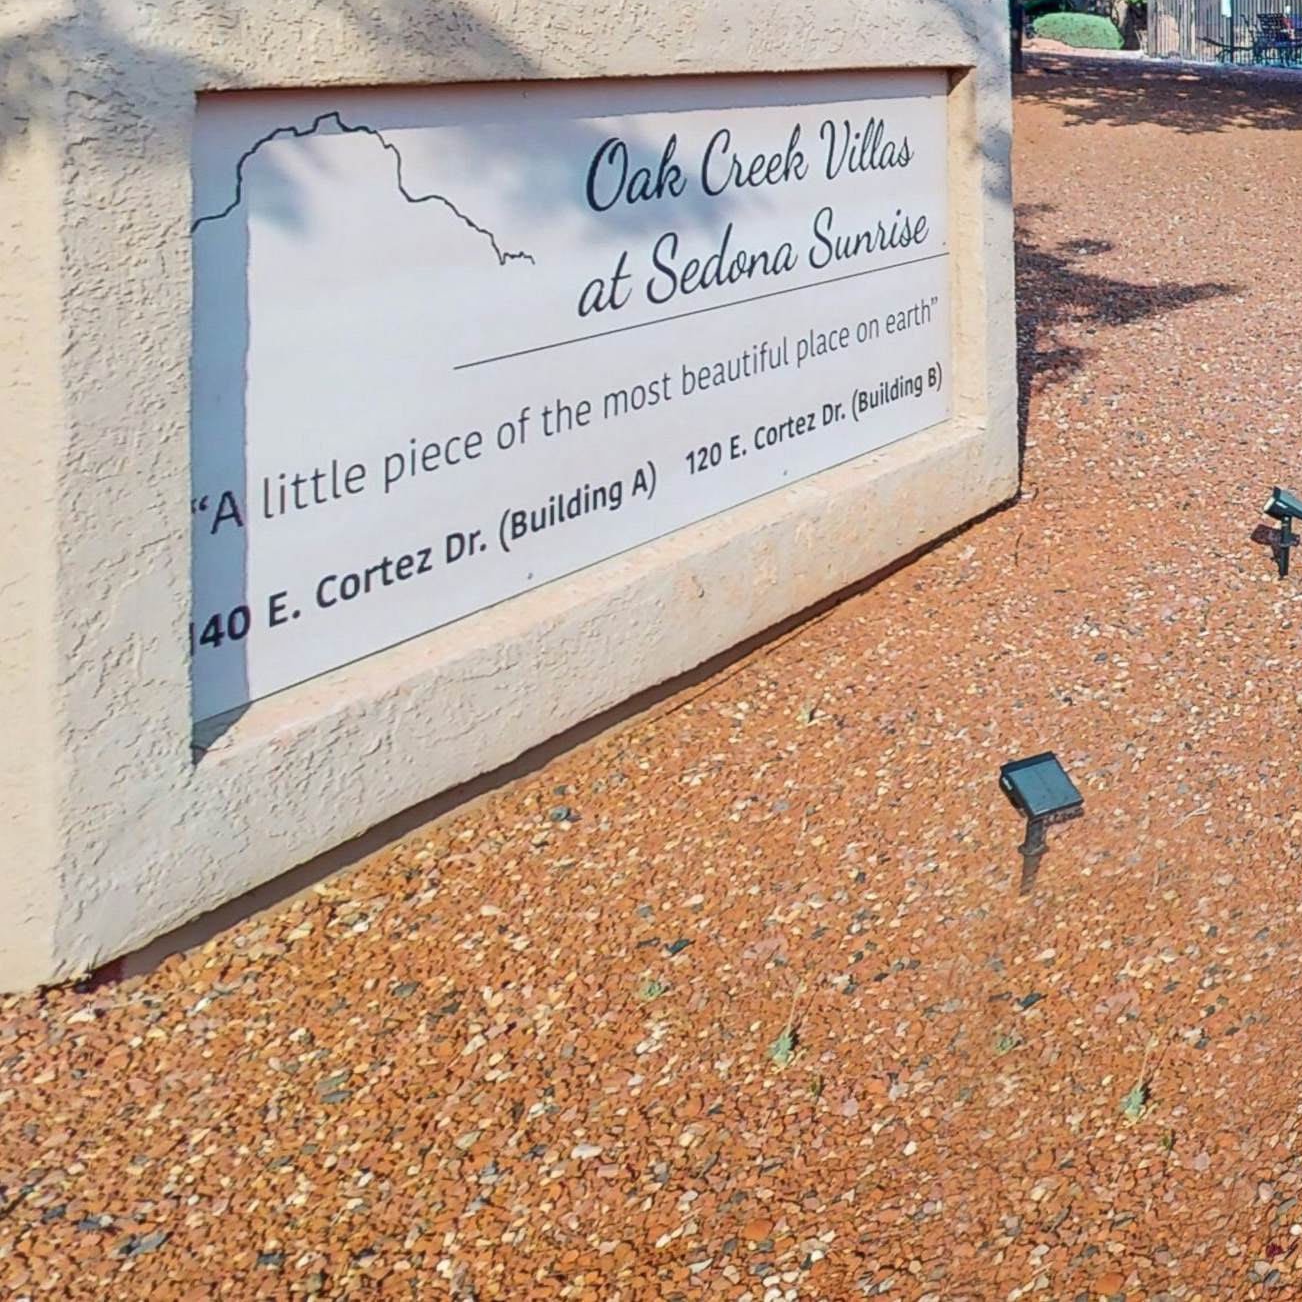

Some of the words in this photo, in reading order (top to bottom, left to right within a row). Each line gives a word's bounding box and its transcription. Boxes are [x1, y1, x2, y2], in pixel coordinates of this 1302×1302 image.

[586, 133, 687, 212] Oak
[702, 123, 810, 197] Creek
[820, 116, 914, 180] Villas
[578, 251, 632, 317] at
[646, 222, 799, 304] Sedona
[809, 206, 929, 269] Sunrise
[263, 459, 366, 518] little
[385, 431, 482, 493] piece
[497, 406, 530, 450] of
[541, 398, 591, 437] the
[603, 371, 671, 419] most
[681, 336, 789, 396] beautiful
[796, 329, 850, 368] place
[856, 318, 879, 343] on
[886, 297, 938, 334] earth”
[685, 442, 721, 475] 120
[730, 435, 747, 460] E.
[754, 412, 816, 450] Cortez
[822, 401, 846, 427] Dr.
[852, 375, 923, 421] (Building
[927, 361, 942, 392] B)
[268, 591, 301, 628] E.
[315, 547, 432, 609] Cortez
[446, 529, 487, 564] Dr.
[499, 480, 622, 552] (Building
[632, 460, 656, 499] A)
